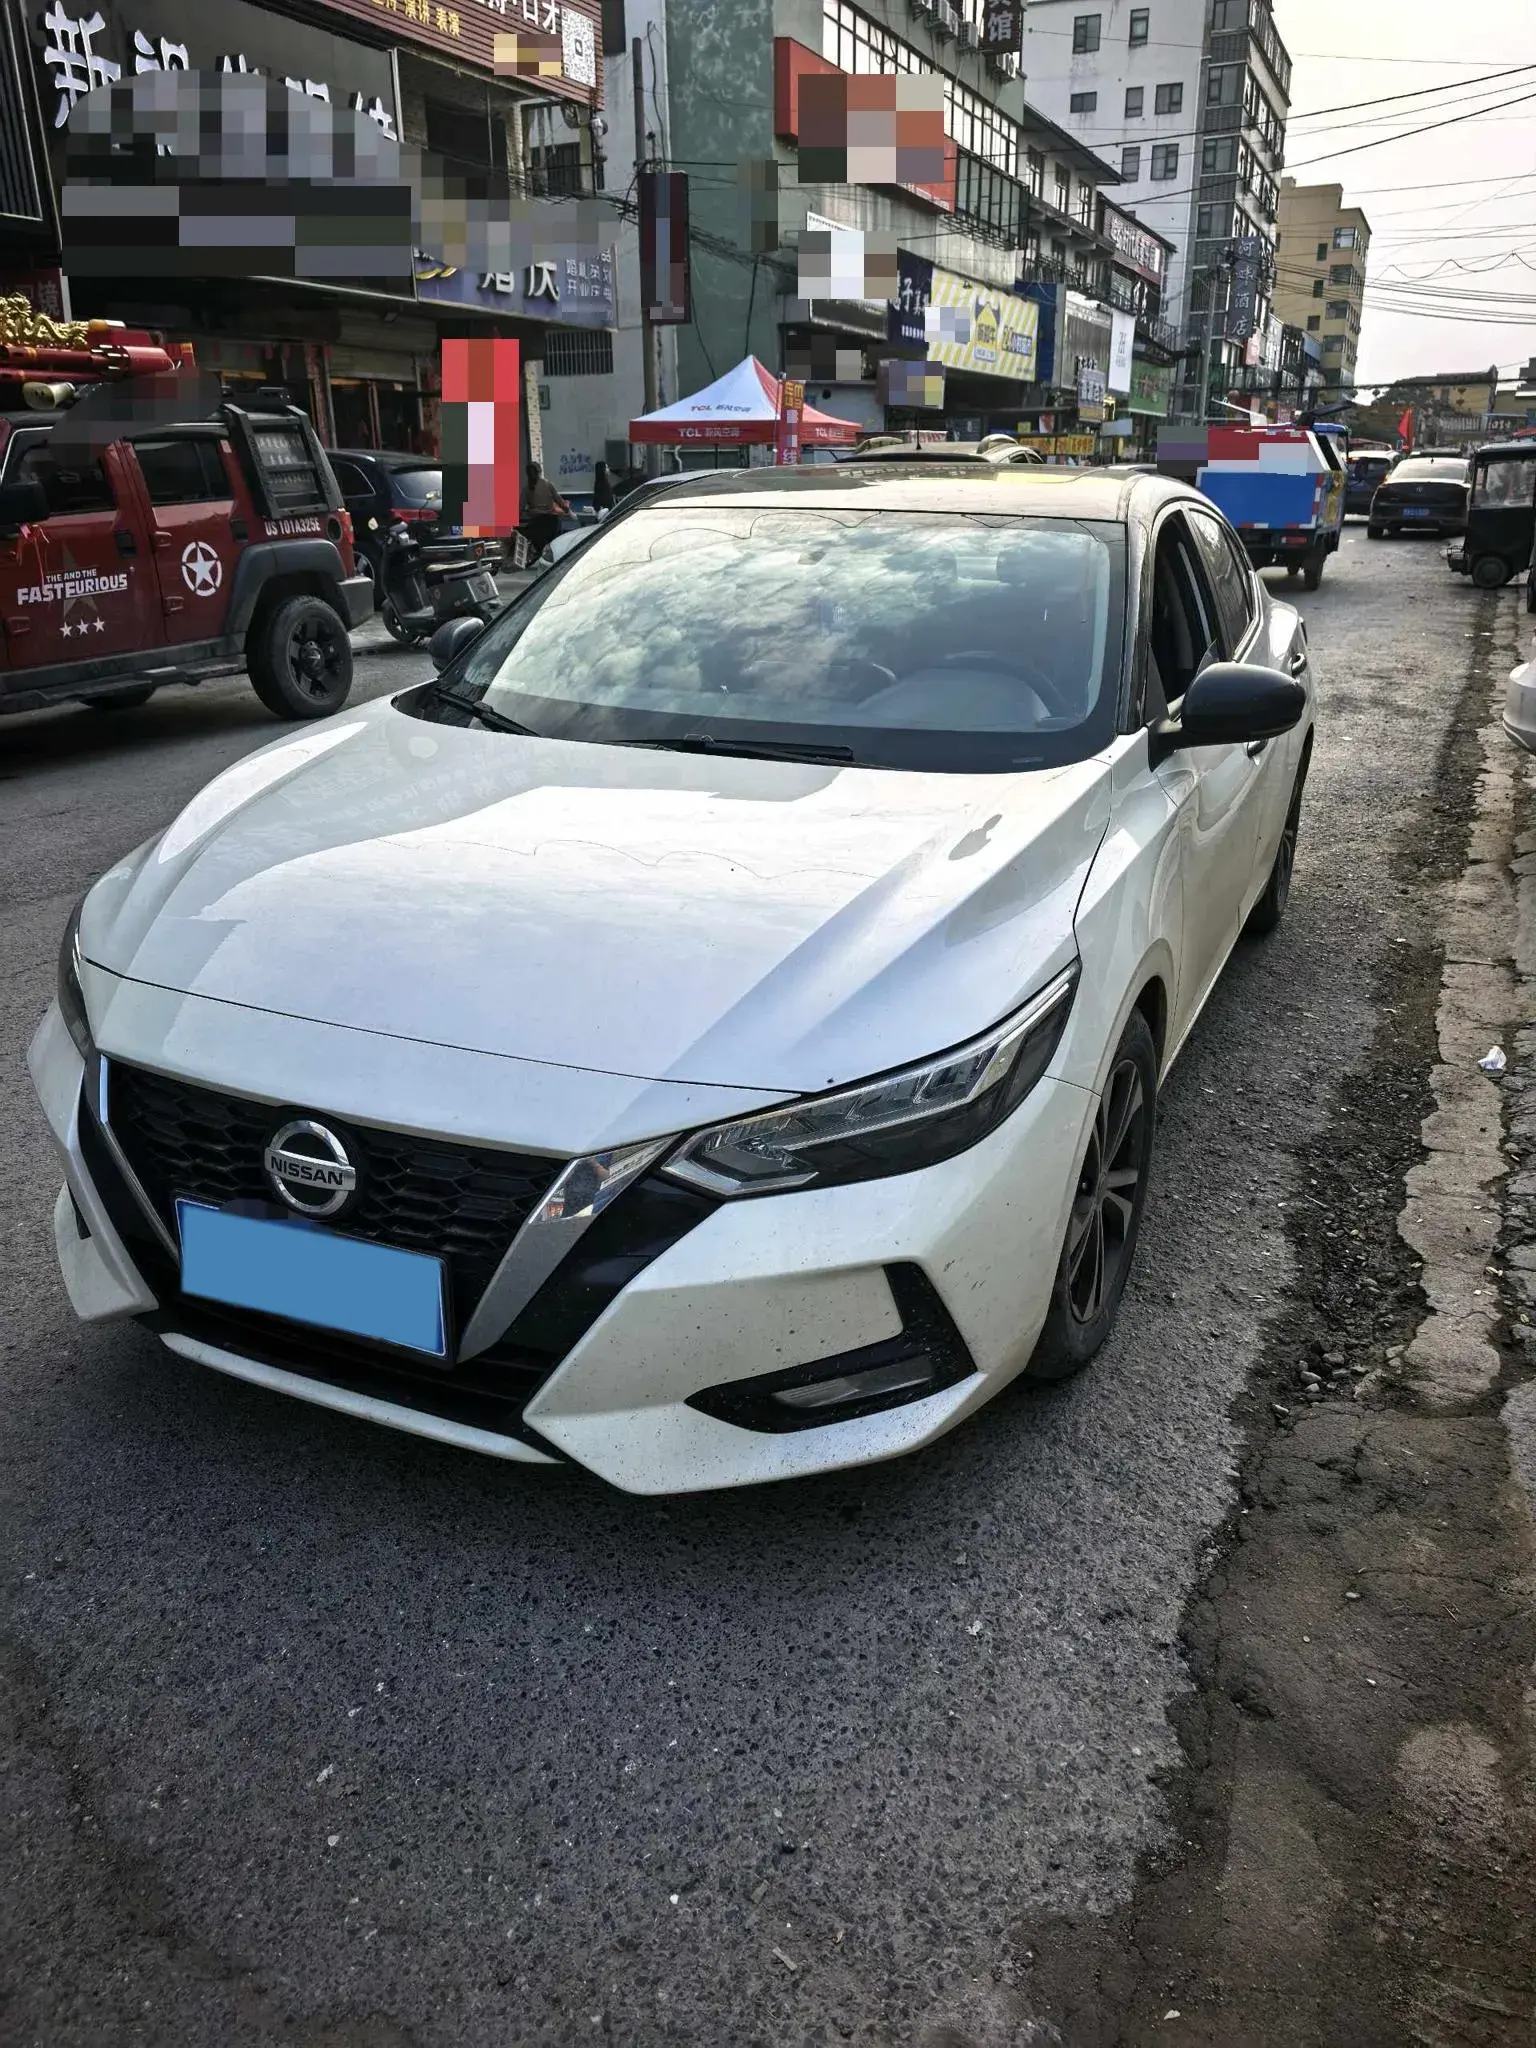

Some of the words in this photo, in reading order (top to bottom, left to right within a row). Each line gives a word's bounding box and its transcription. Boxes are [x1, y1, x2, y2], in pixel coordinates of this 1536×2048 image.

[436, 7, 460, 37] 表演
[691, 404, 712, 412] TCL
[678, 427, 702, 437] TCL
[815, 427, 828, 437] TCL
[264, 521, 278, 535] US
[46, 574, 62, 583] THE
[63, 570, 81, 580] AND
[82, 568, 97, 577] THE
[271, 1155, 343, 1186] NISSAN
